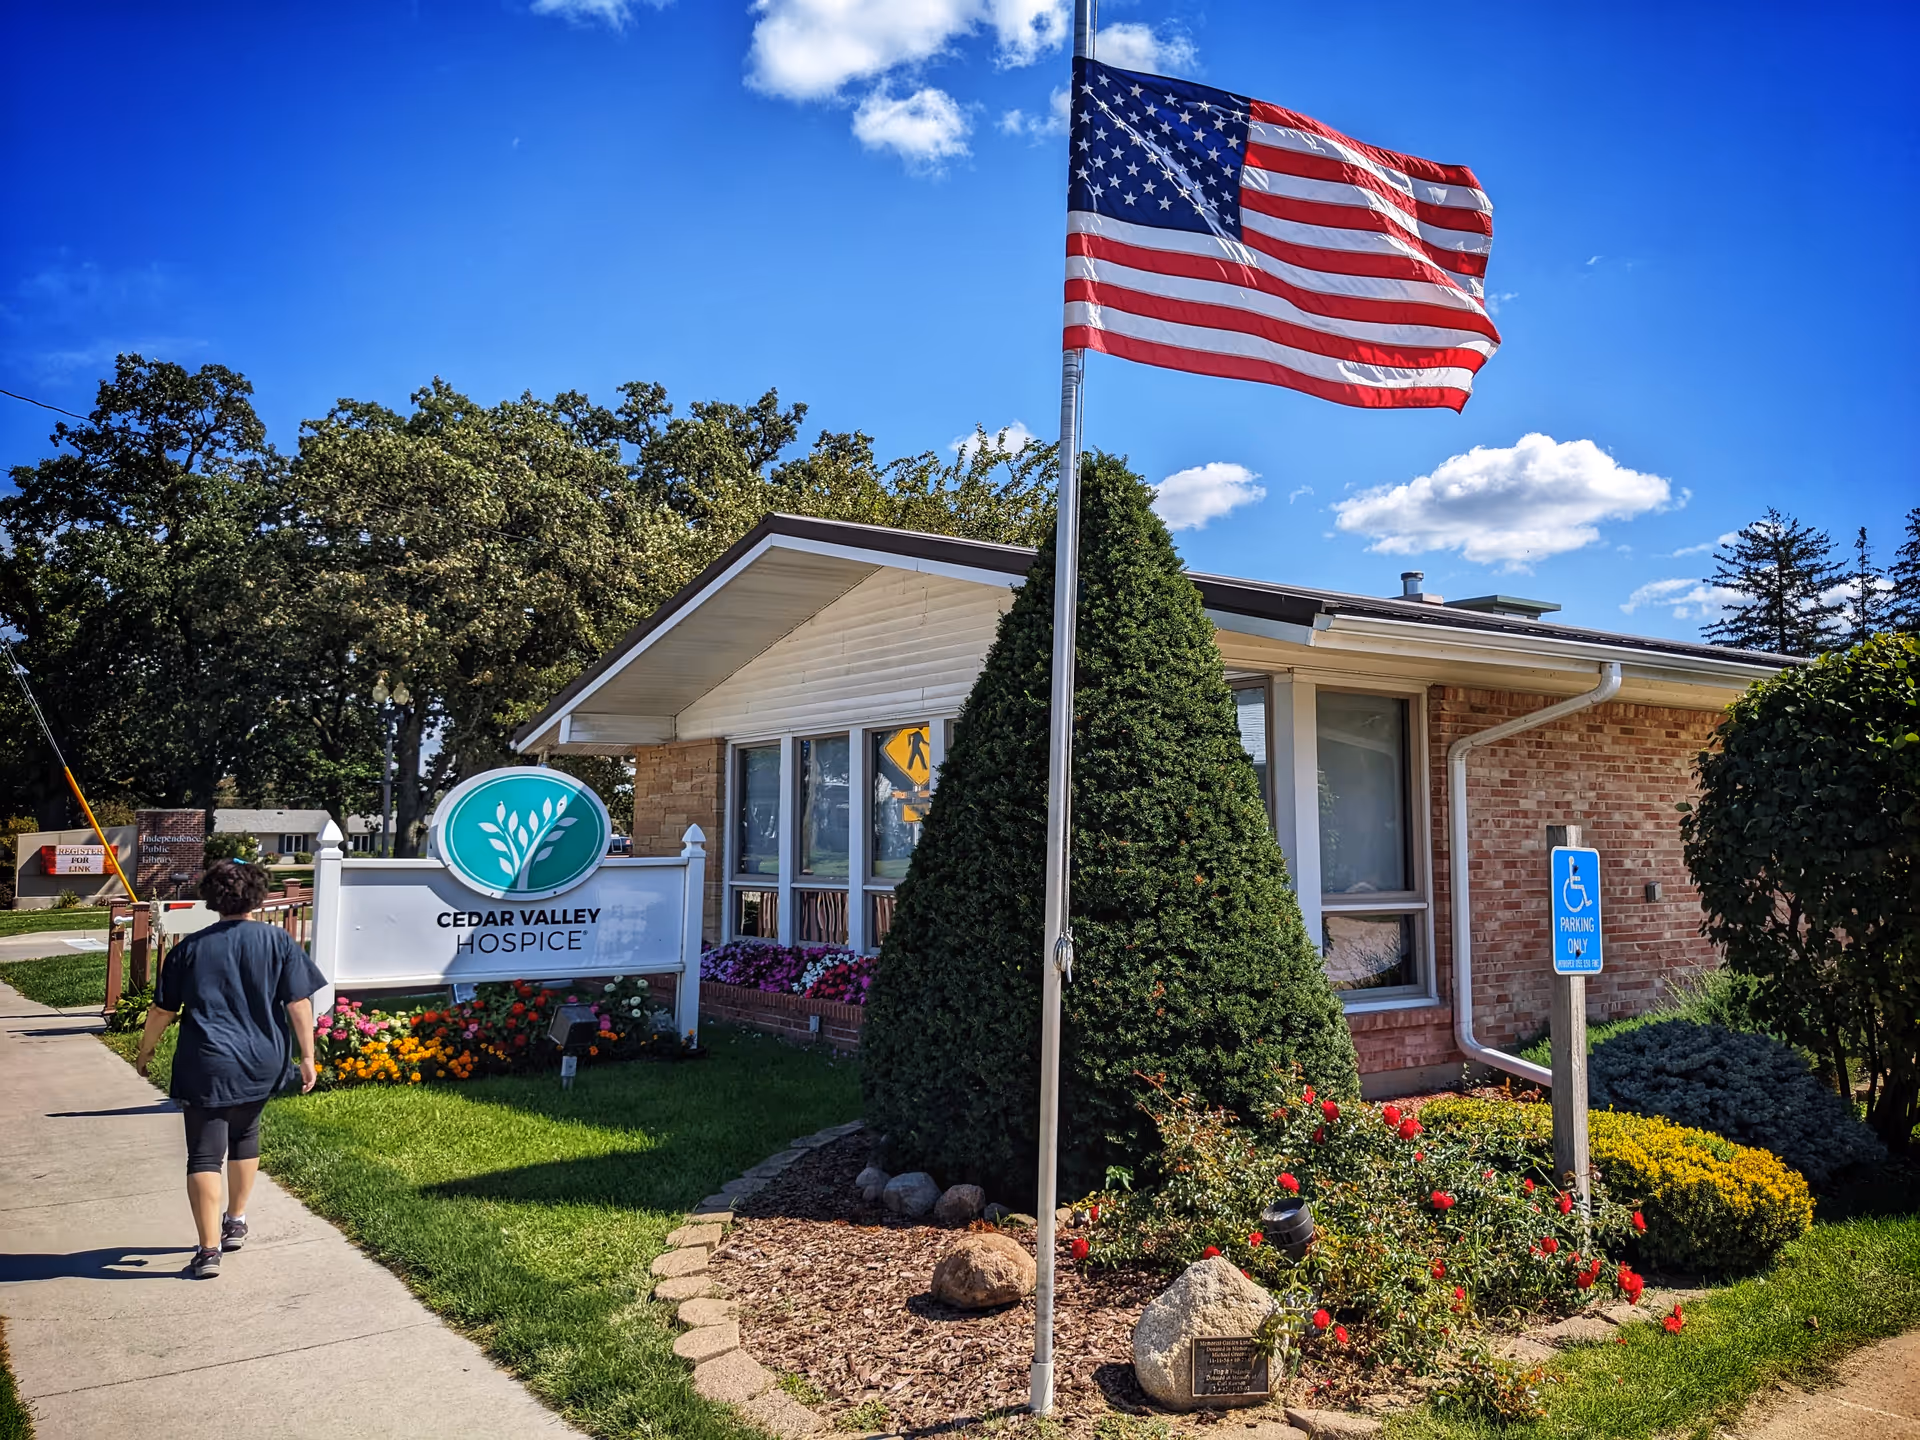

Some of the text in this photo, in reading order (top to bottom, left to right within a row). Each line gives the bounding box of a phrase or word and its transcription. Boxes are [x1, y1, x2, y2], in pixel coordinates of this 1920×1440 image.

[142, 834, 201, 844] Independence
[58, 847, 104, 856] REGISTER
[142, 845, 170, 854] Public
[71, 857, 90, 865] FOR
[142, 856, 173, 865] Library
[68, 865, 91, 873] LINK
[436, 908, 602, 928] CEDAR VALLEY
[1560, 916, 1595, 933] PARKING
[1567, 937, 1589, 954] ONLY
